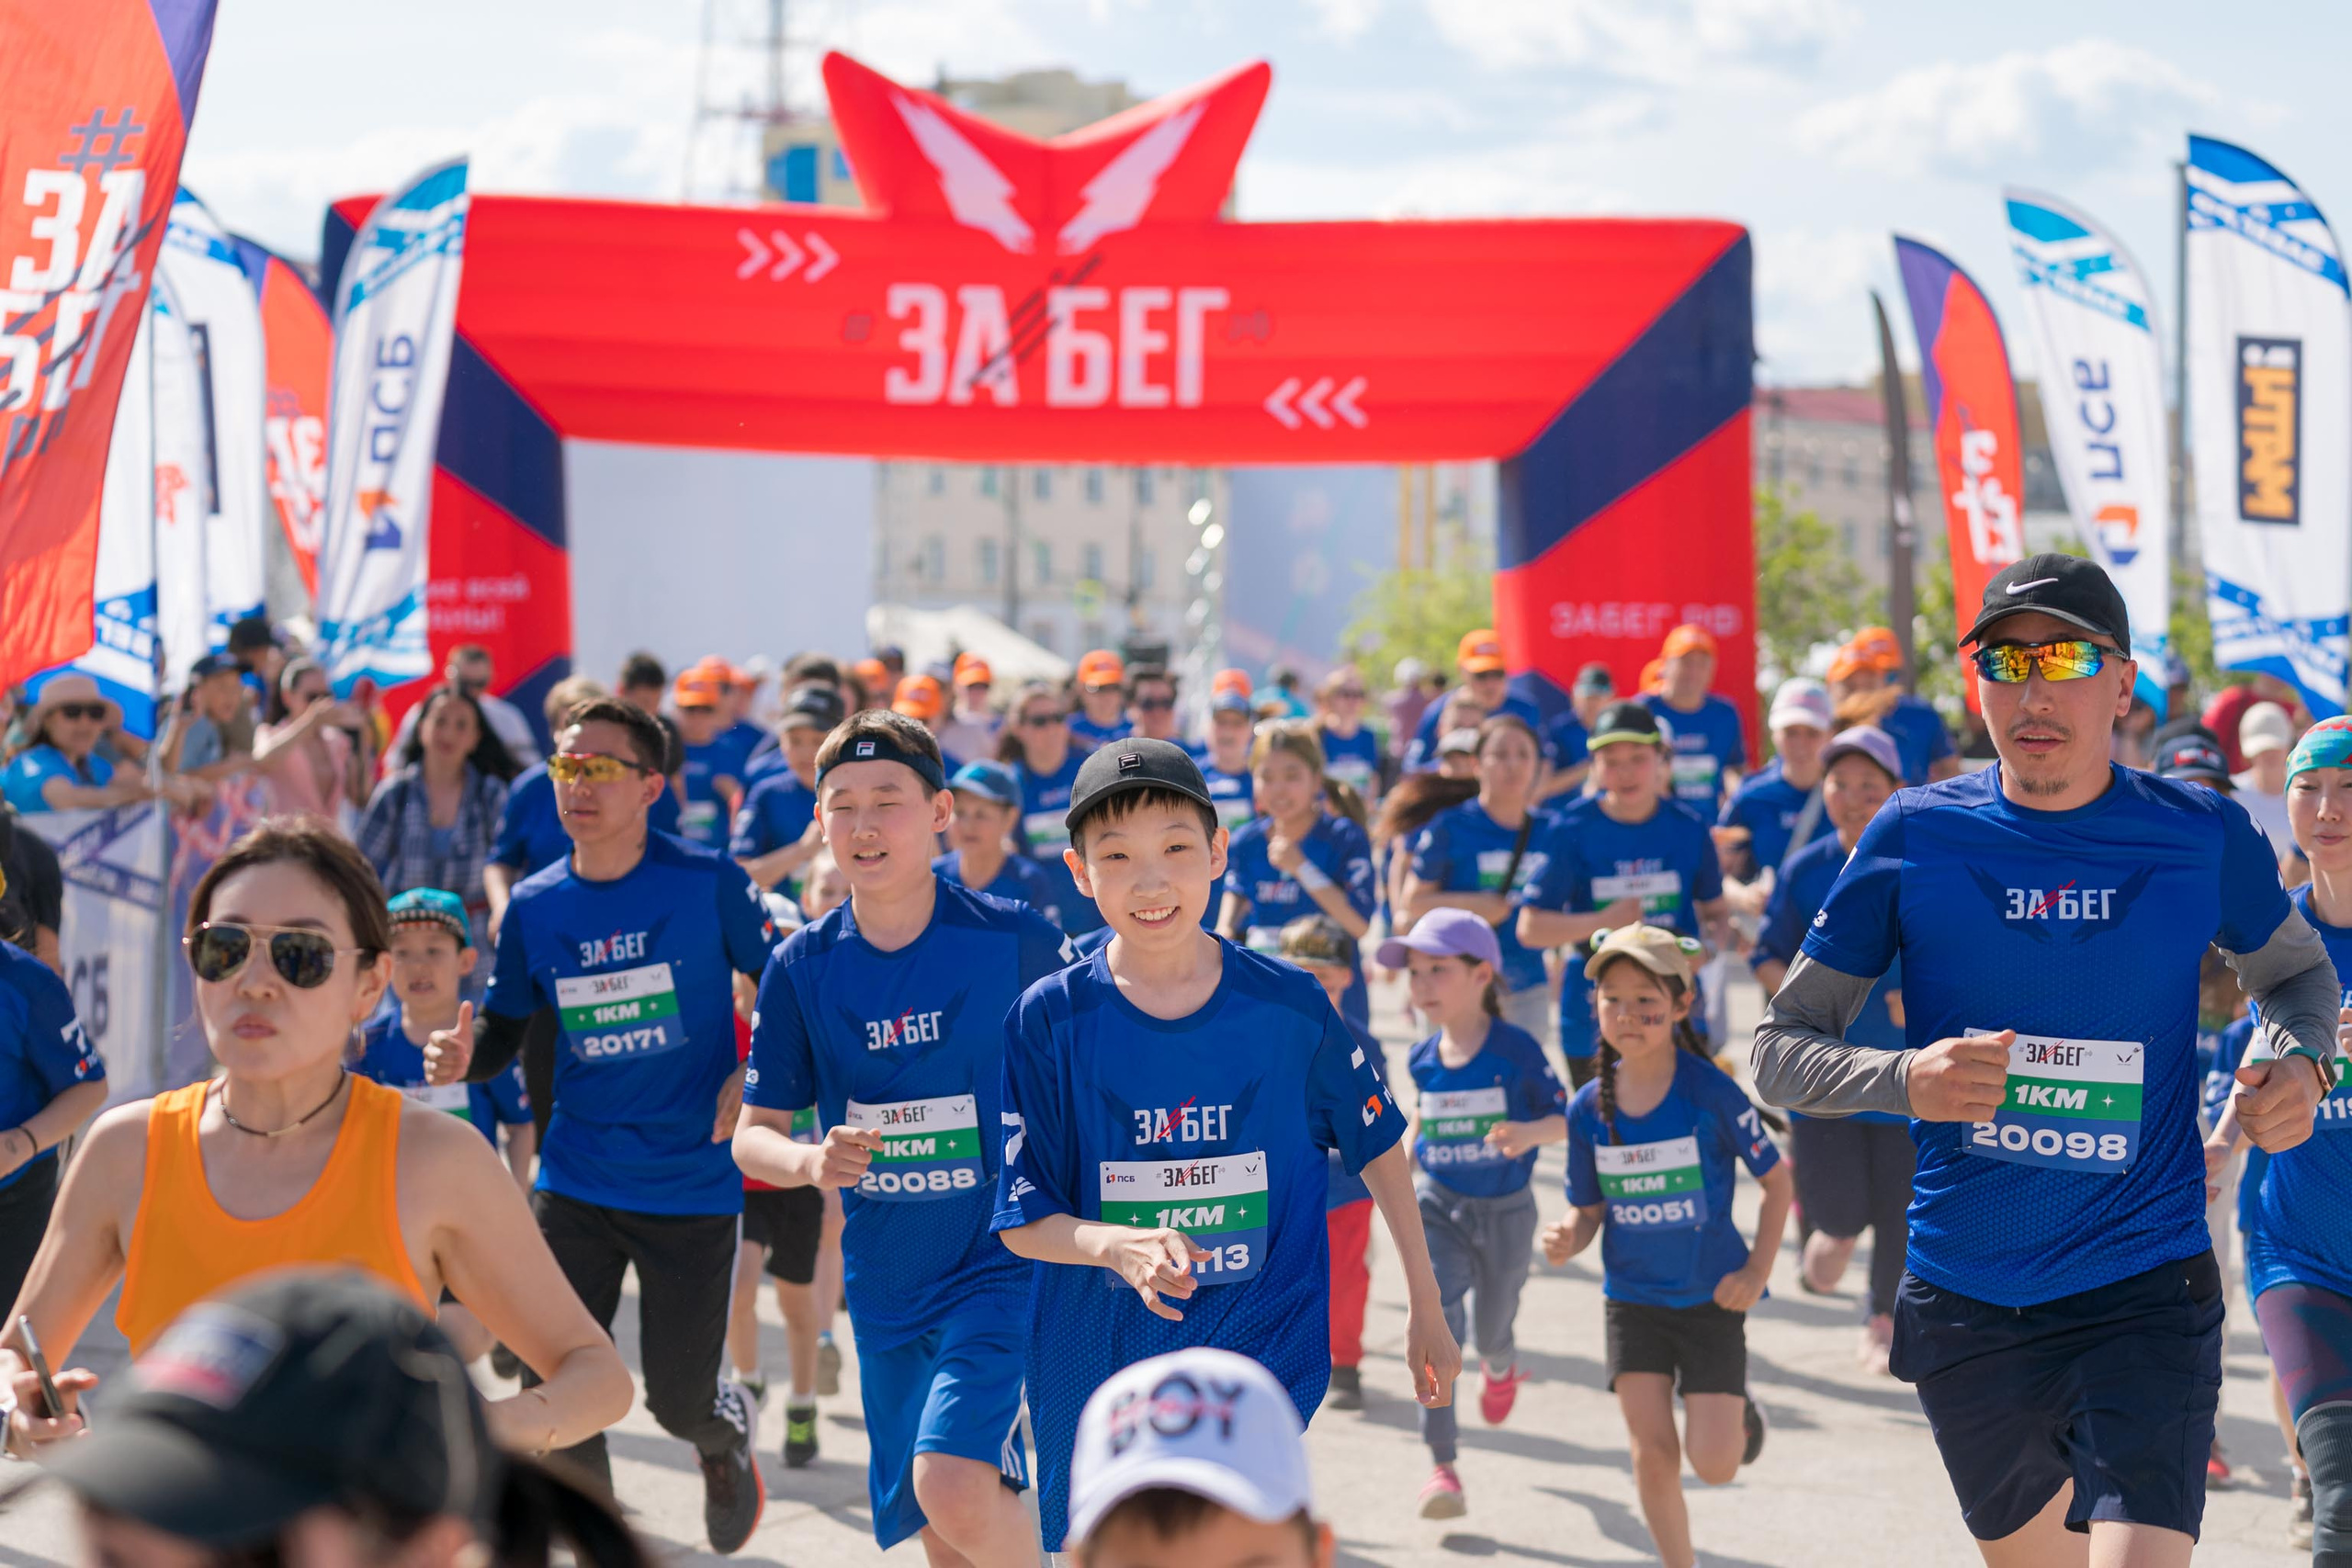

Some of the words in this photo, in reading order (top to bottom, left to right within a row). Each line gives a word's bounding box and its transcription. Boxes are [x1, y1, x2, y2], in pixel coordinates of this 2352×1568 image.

[583, 1026, 666, 1056] 20171
[1973, 1121, 2128, 1161] 20098
[862, 1168, 977, 1193] 20088
[1117, 1175, 1136, 1183] ПСБ
[1612, 1199, 1695, 1224] 20051
